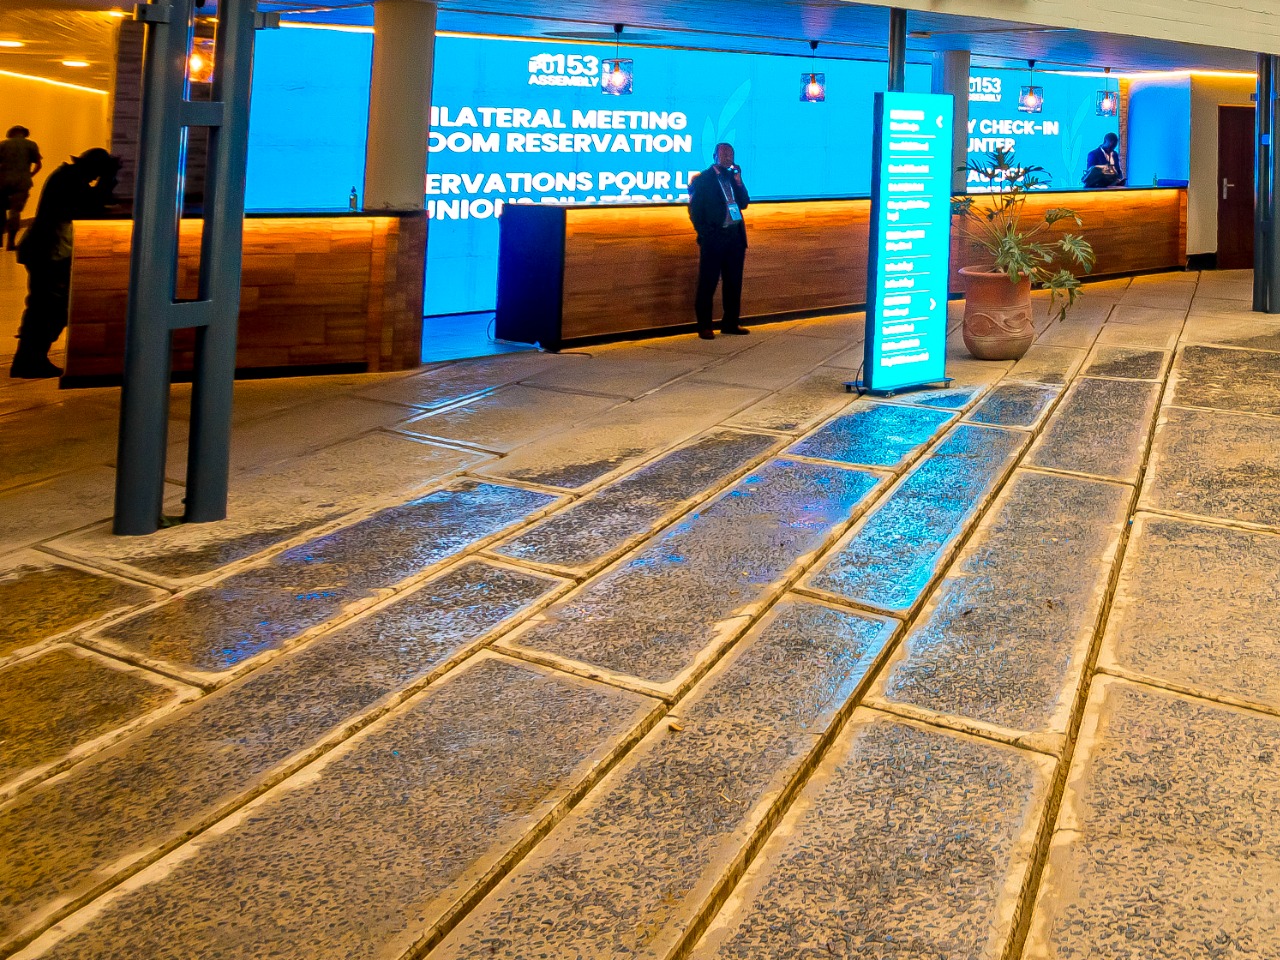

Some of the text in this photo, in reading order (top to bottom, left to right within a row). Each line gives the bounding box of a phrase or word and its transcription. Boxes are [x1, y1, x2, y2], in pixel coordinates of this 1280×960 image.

[572, 109, 688, 130] MEETING
[980, 119, 1059, 135] CHECK-IN
[506, 132, 693, 153] RESERVATION
[425, 171, 594, 195] ERVATIONS
[598, 170, 671, 191] POUR
